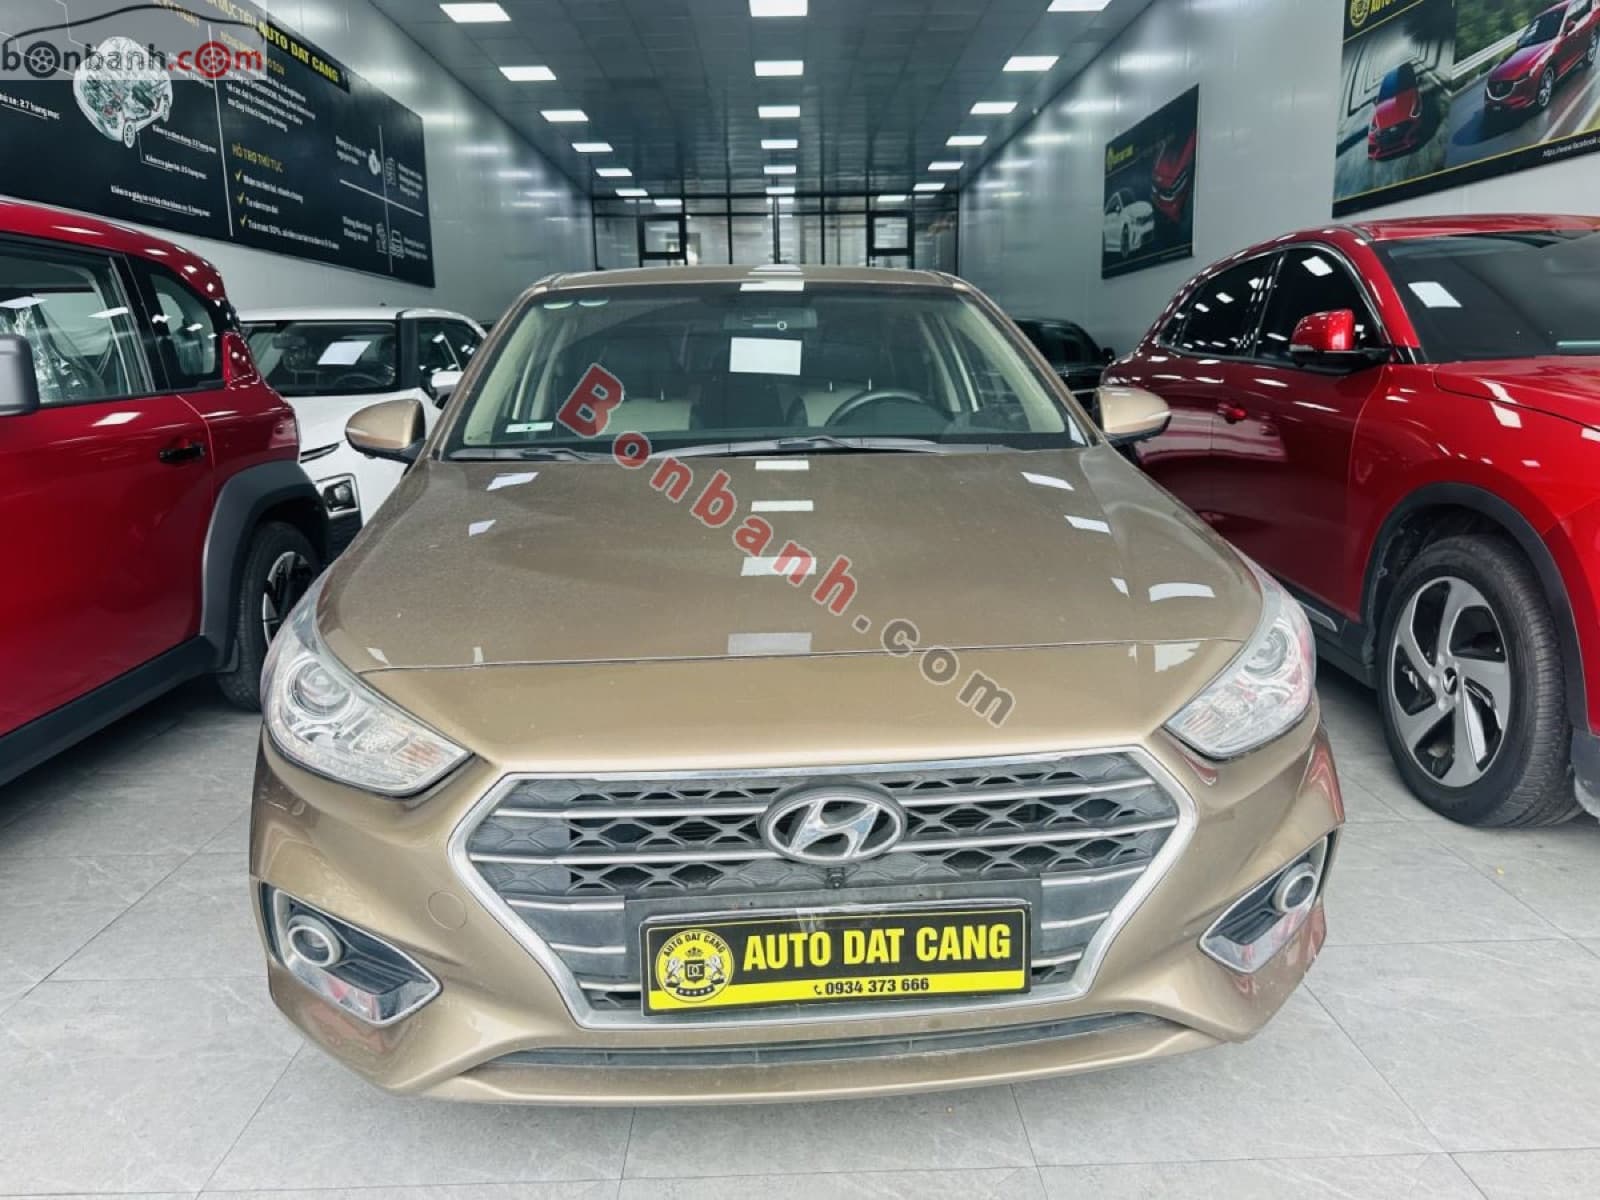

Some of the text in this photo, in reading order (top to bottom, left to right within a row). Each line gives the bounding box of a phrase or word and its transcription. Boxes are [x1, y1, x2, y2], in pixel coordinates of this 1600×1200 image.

[259, 20, 288, 49] AUTO
[291, 42, 310, 65] DAT
[311, 55, 340, 82] CANG
[664, 933, 726, 957] AUTO DAT CANG
[743, 923, 1011, 972] AUTO DAT CANG
[825, 977, 930, 996] 0934 373 666
